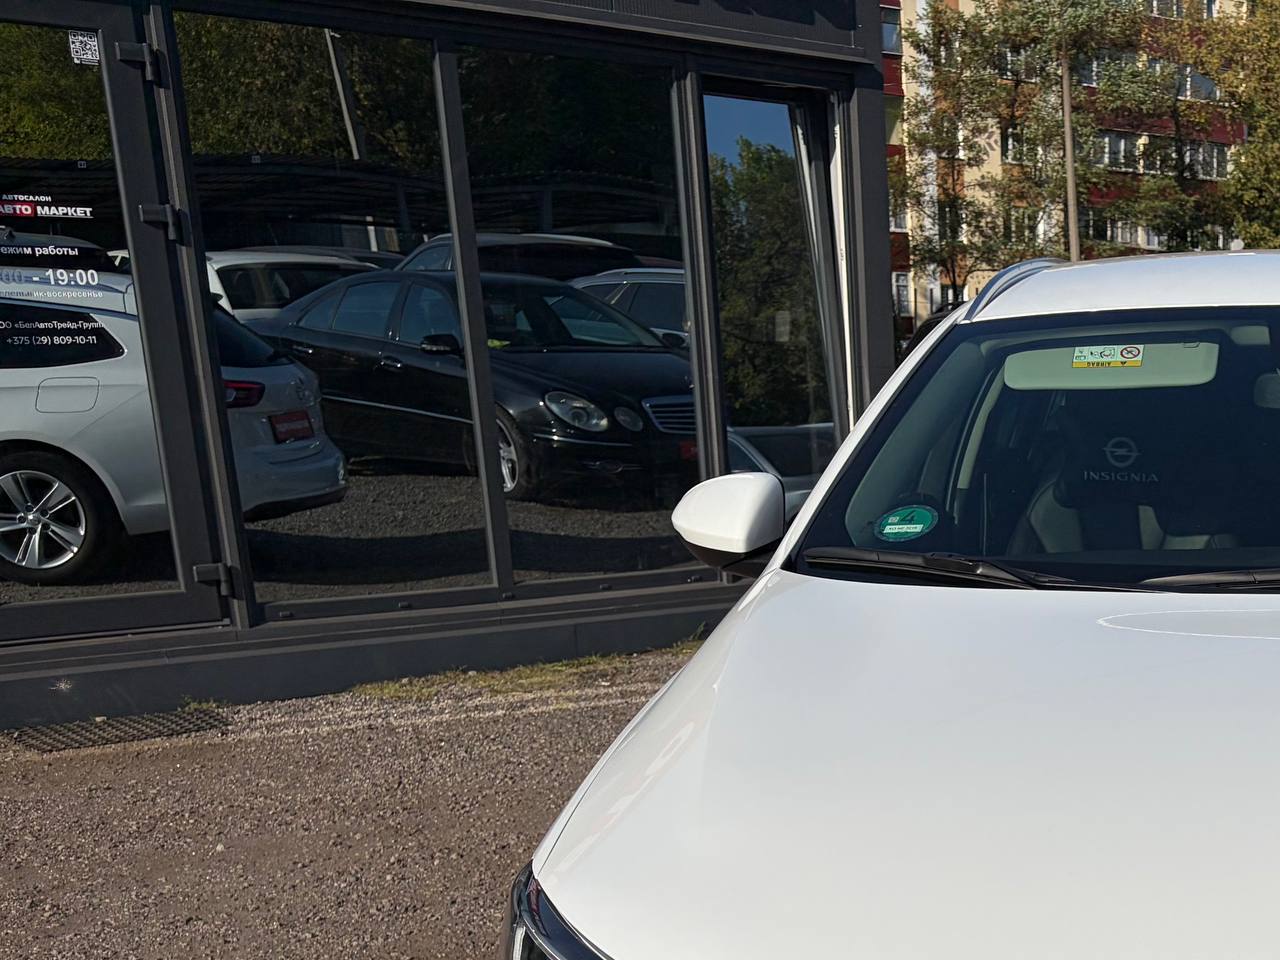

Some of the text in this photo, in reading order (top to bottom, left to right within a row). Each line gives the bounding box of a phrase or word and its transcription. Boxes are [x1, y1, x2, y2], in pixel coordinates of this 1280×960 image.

[2, 194, 52, 202] АВТОСАЛОН
[34, 246, 79, 257] работы
[45, 268, 99, 286] 19:00
[6, 335, 97, 346] +375 (29) 809-10-11
[1083, 471, 1159, 483] INSIGNIA
[900, 509, 917, 525] 4
